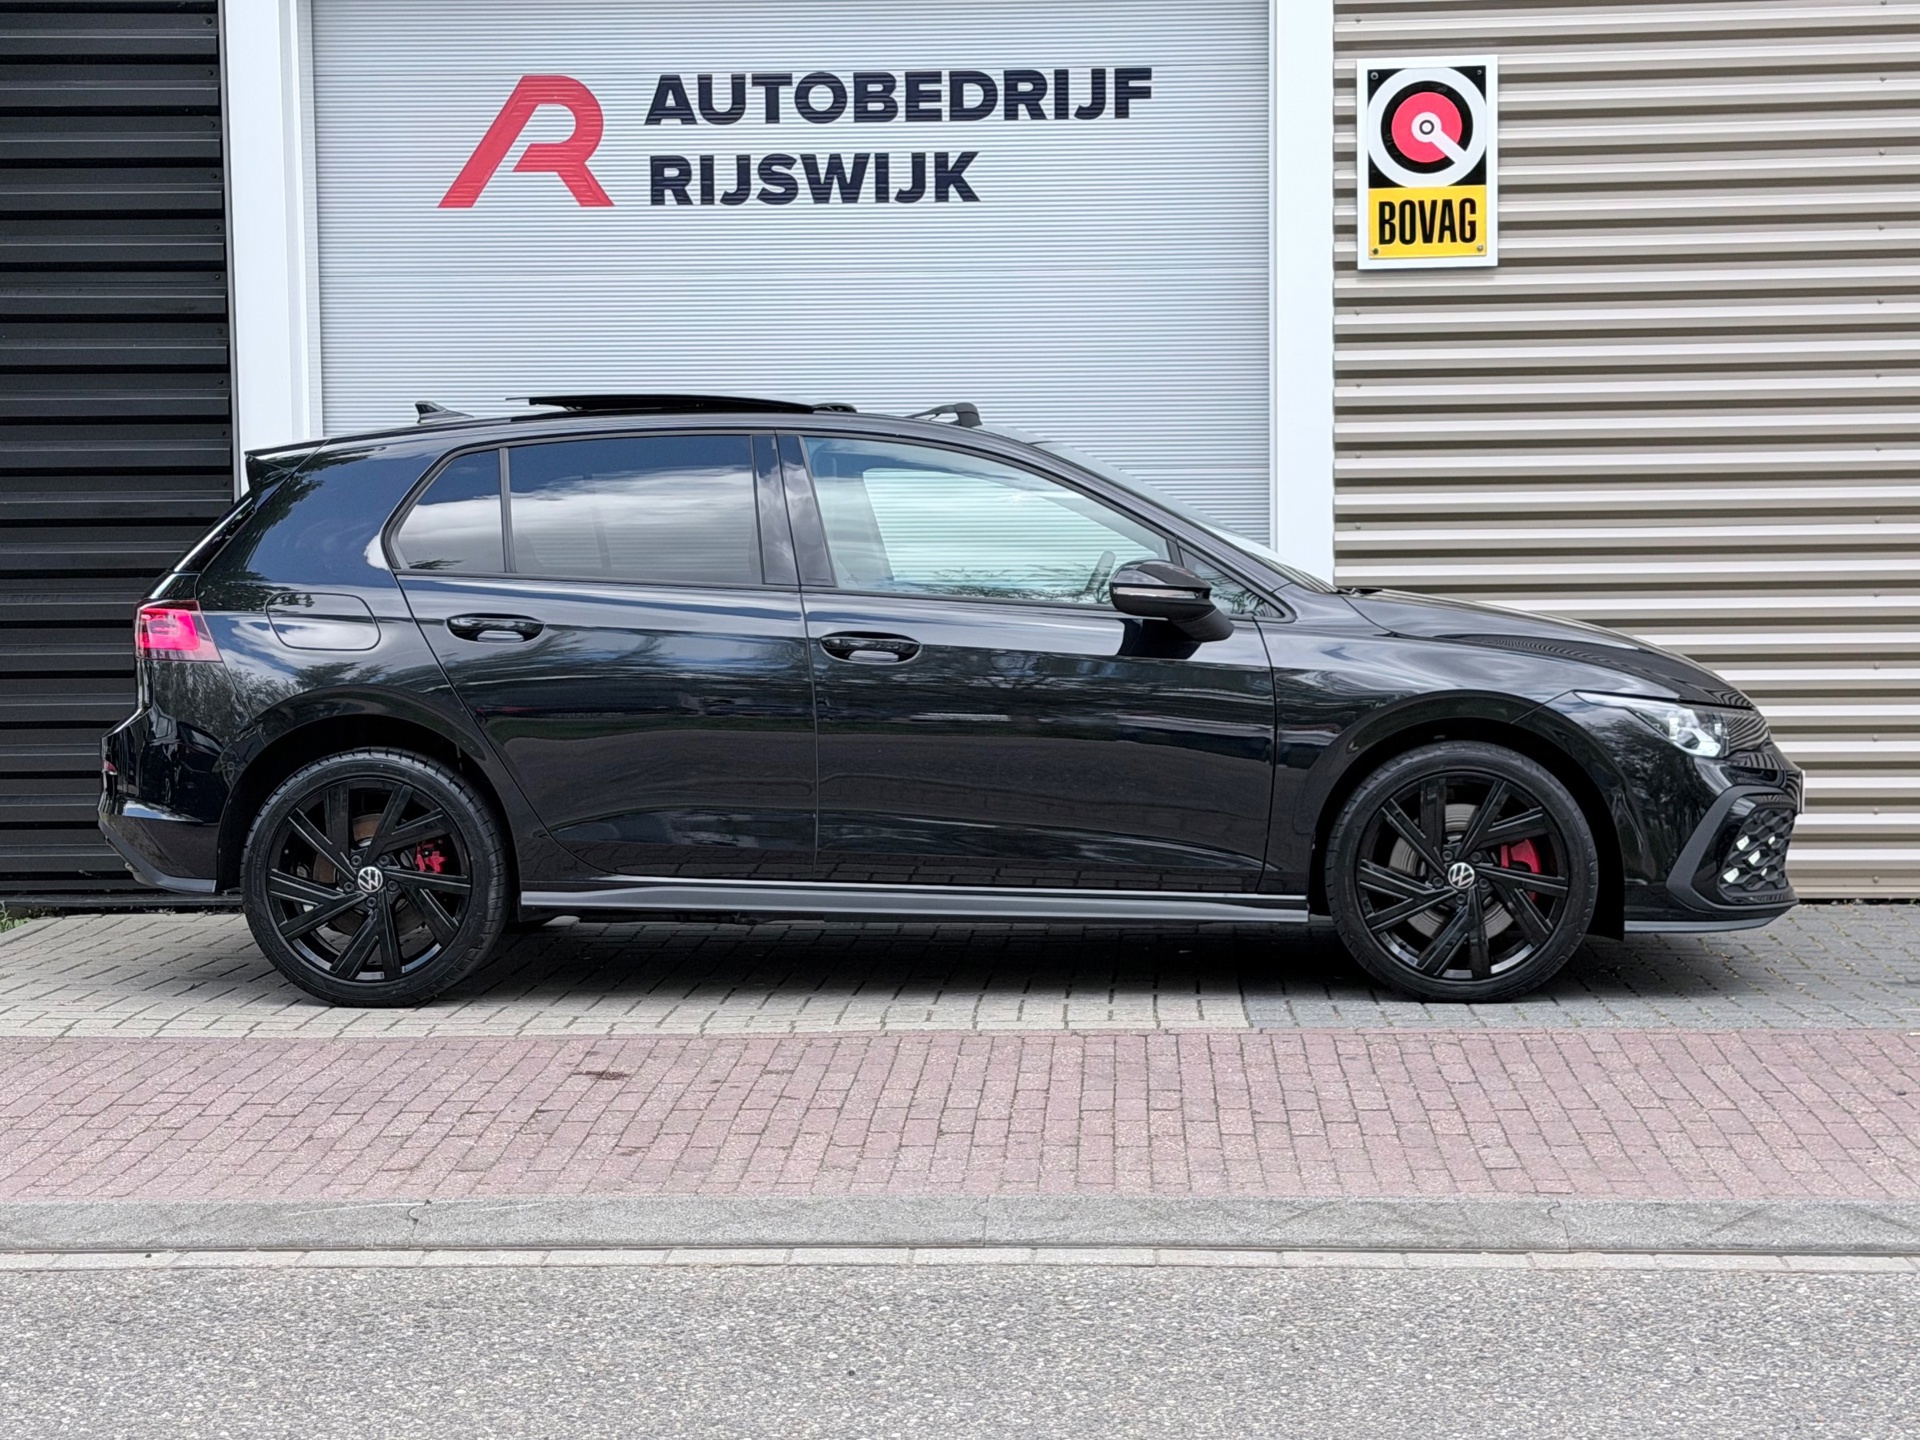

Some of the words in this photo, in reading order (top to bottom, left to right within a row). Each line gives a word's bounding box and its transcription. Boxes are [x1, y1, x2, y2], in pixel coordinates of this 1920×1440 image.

[645, 68, 1152, 125] AUTOBEDRIJF
[650, 152, 980, 206] RIJSWIJK
[1378, 197, 1477, 245] BOVAG
[358, 866, 383, 893] VW
[1448, 862, 1475, 890] VW
